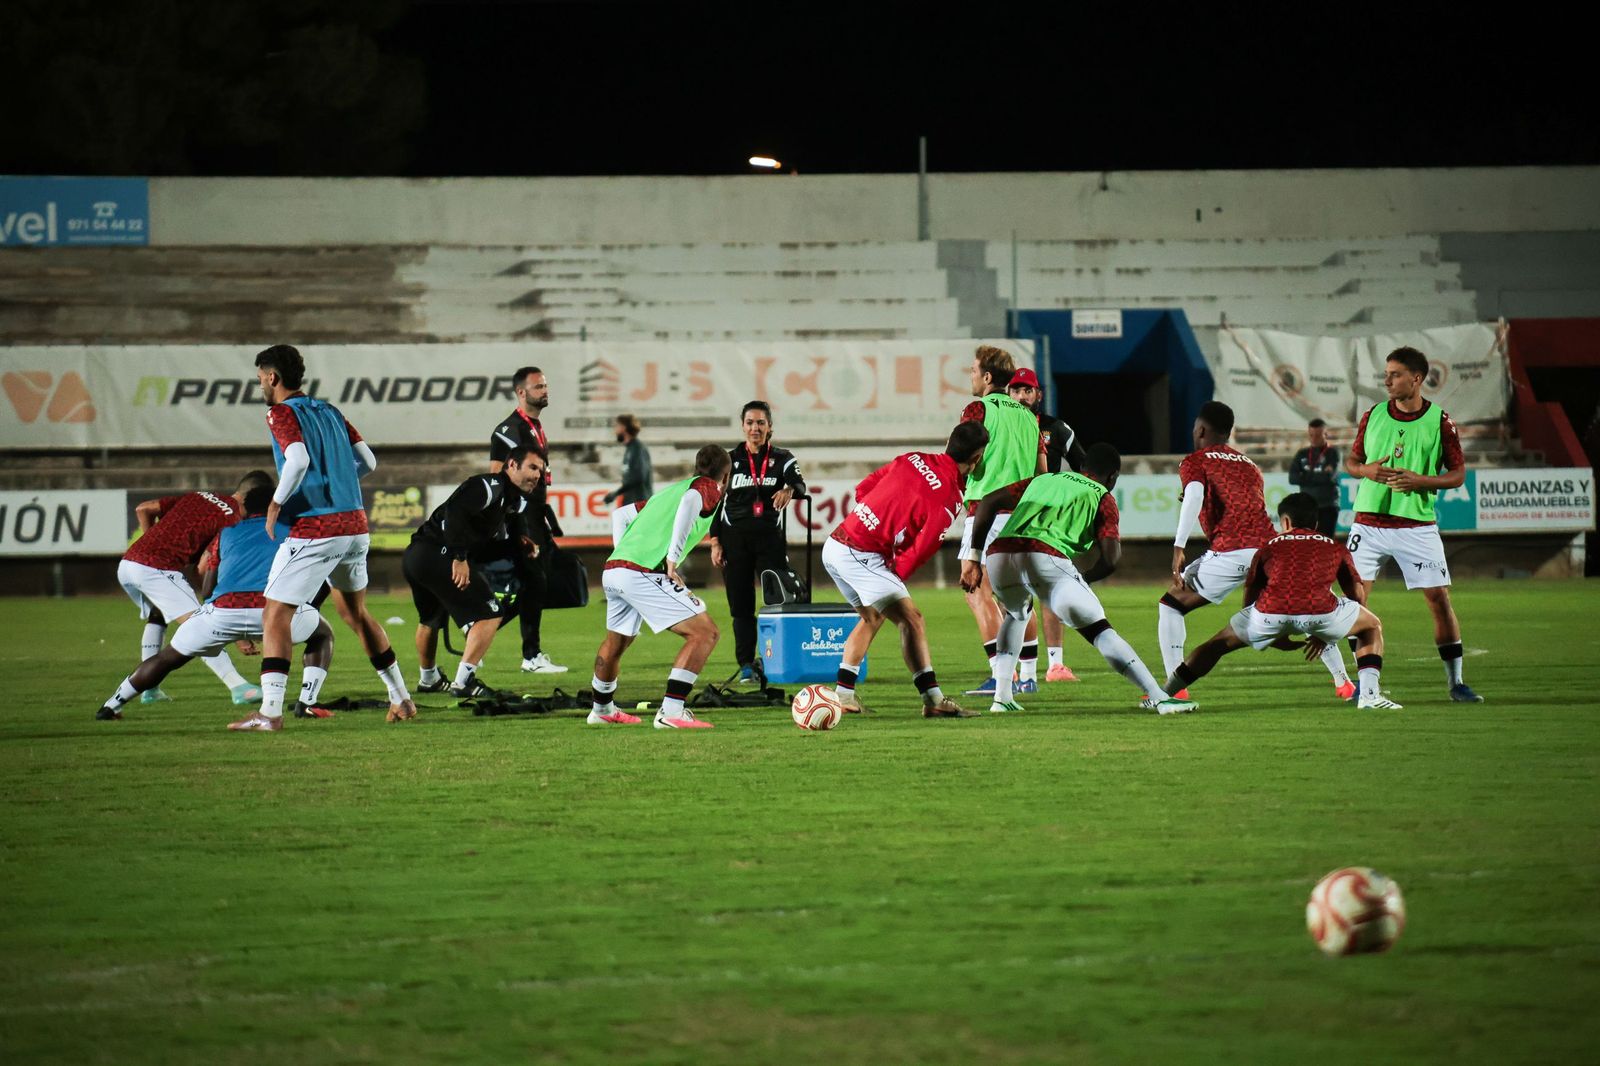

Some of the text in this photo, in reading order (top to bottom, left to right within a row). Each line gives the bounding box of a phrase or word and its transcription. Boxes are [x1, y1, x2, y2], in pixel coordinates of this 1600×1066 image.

[170, 376, 517, 405] PADL INDOOR
[908, 453, 942, 491] macron
[1062, 473, 1102, 493] macron
[1480, 480, 1574, 495] MUDANZAS
[1579, 480, 1589, 493] Y
[1480, 496, 1590, 508] GUARDAMUEBLES
[1481, 511, 1528, 520] ELEVADOR
[1546, 510, 1590, 519] MUEBLES
[1268, 534, 1334, 545] macron
[1348, 533, 1362, 552] 8
